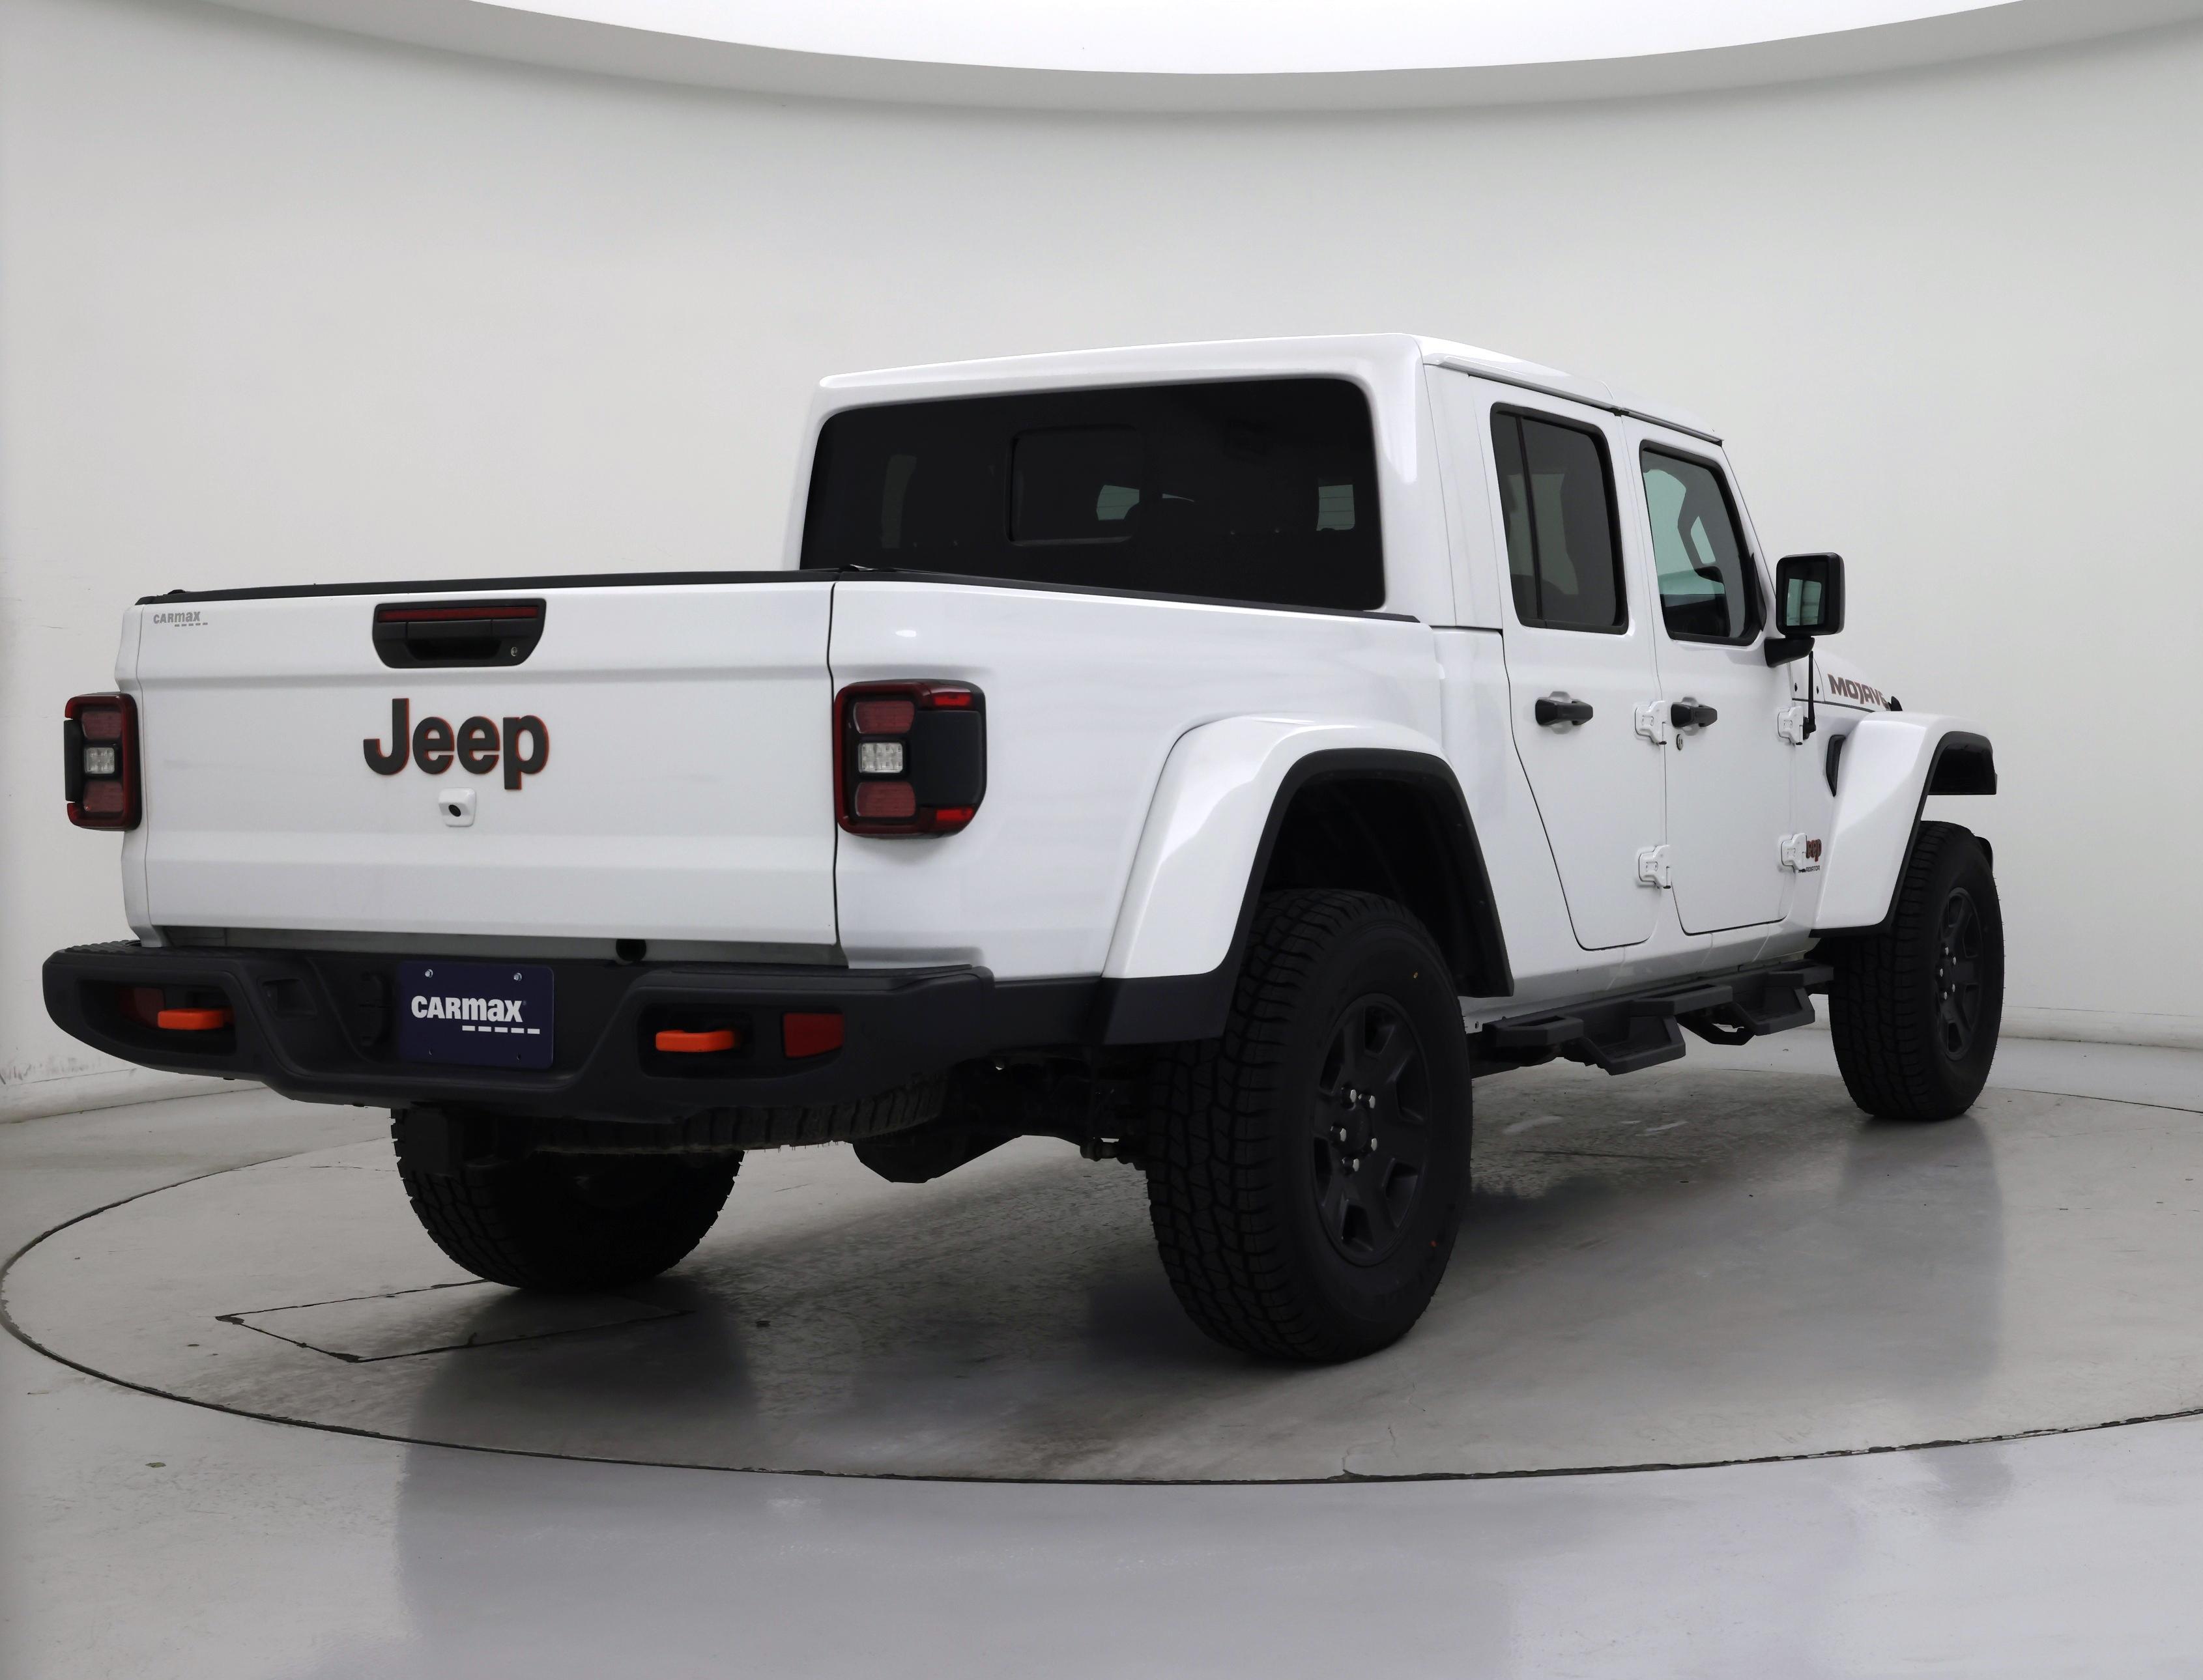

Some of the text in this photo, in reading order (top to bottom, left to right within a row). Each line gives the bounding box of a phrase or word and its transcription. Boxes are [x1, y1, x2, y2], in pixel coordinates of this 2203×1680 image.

[1828, 674, 1890, 710] MOJAVE
[364, 698, 549, 790] Jeep
[1806, 839, 1822, 862] eep
[411, 995, 523, 1023] CARmax
